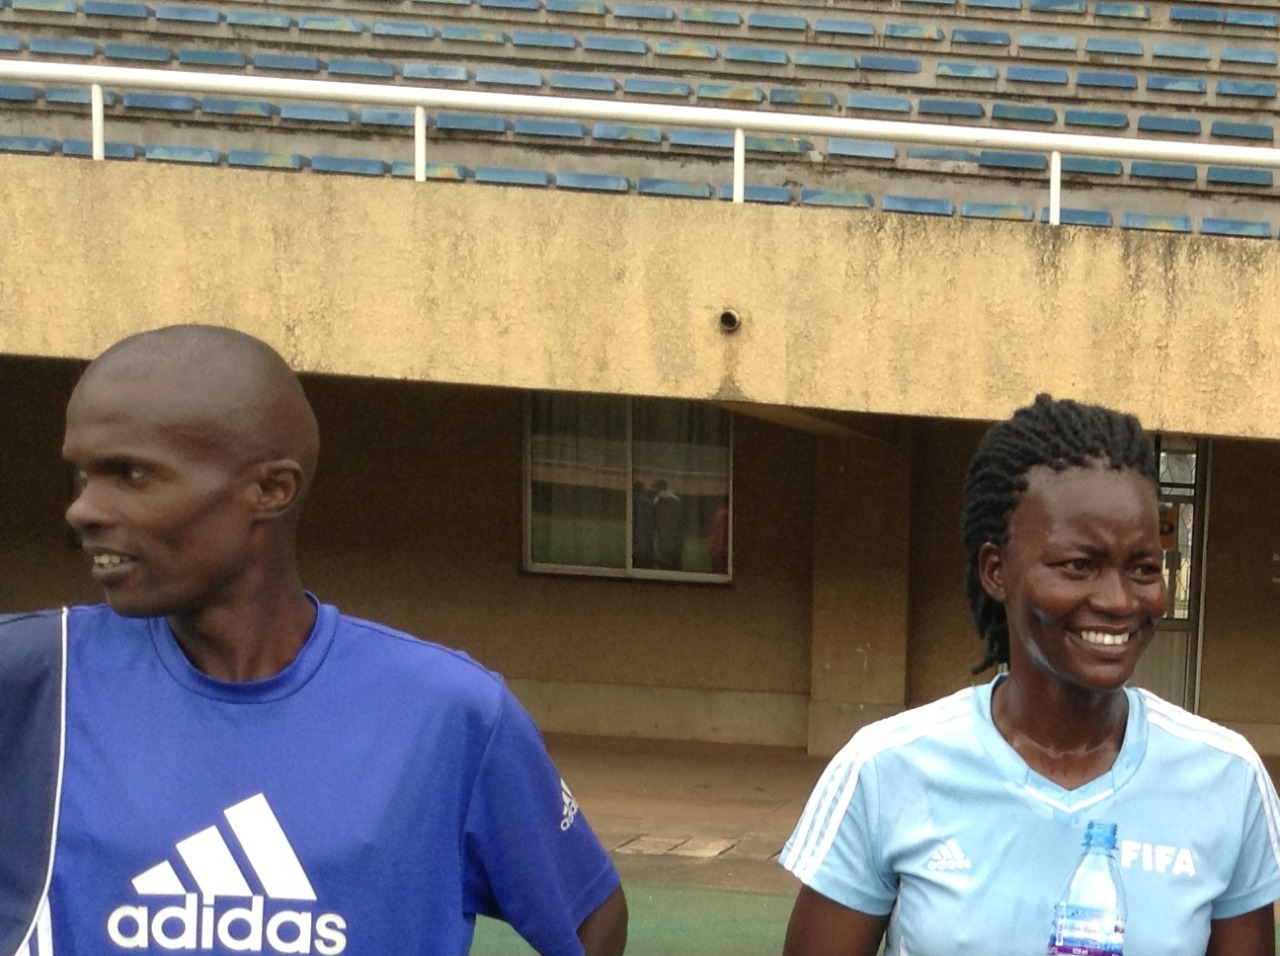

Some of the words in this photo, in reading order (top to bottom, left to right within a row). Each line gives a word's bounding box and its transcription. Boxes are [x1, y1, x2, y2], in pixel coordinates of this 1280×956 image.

[927, 857, 972, 871] adidas
[1120, 840, 1197, 877] FIFA
[107, 893, 348, 956] adidas
